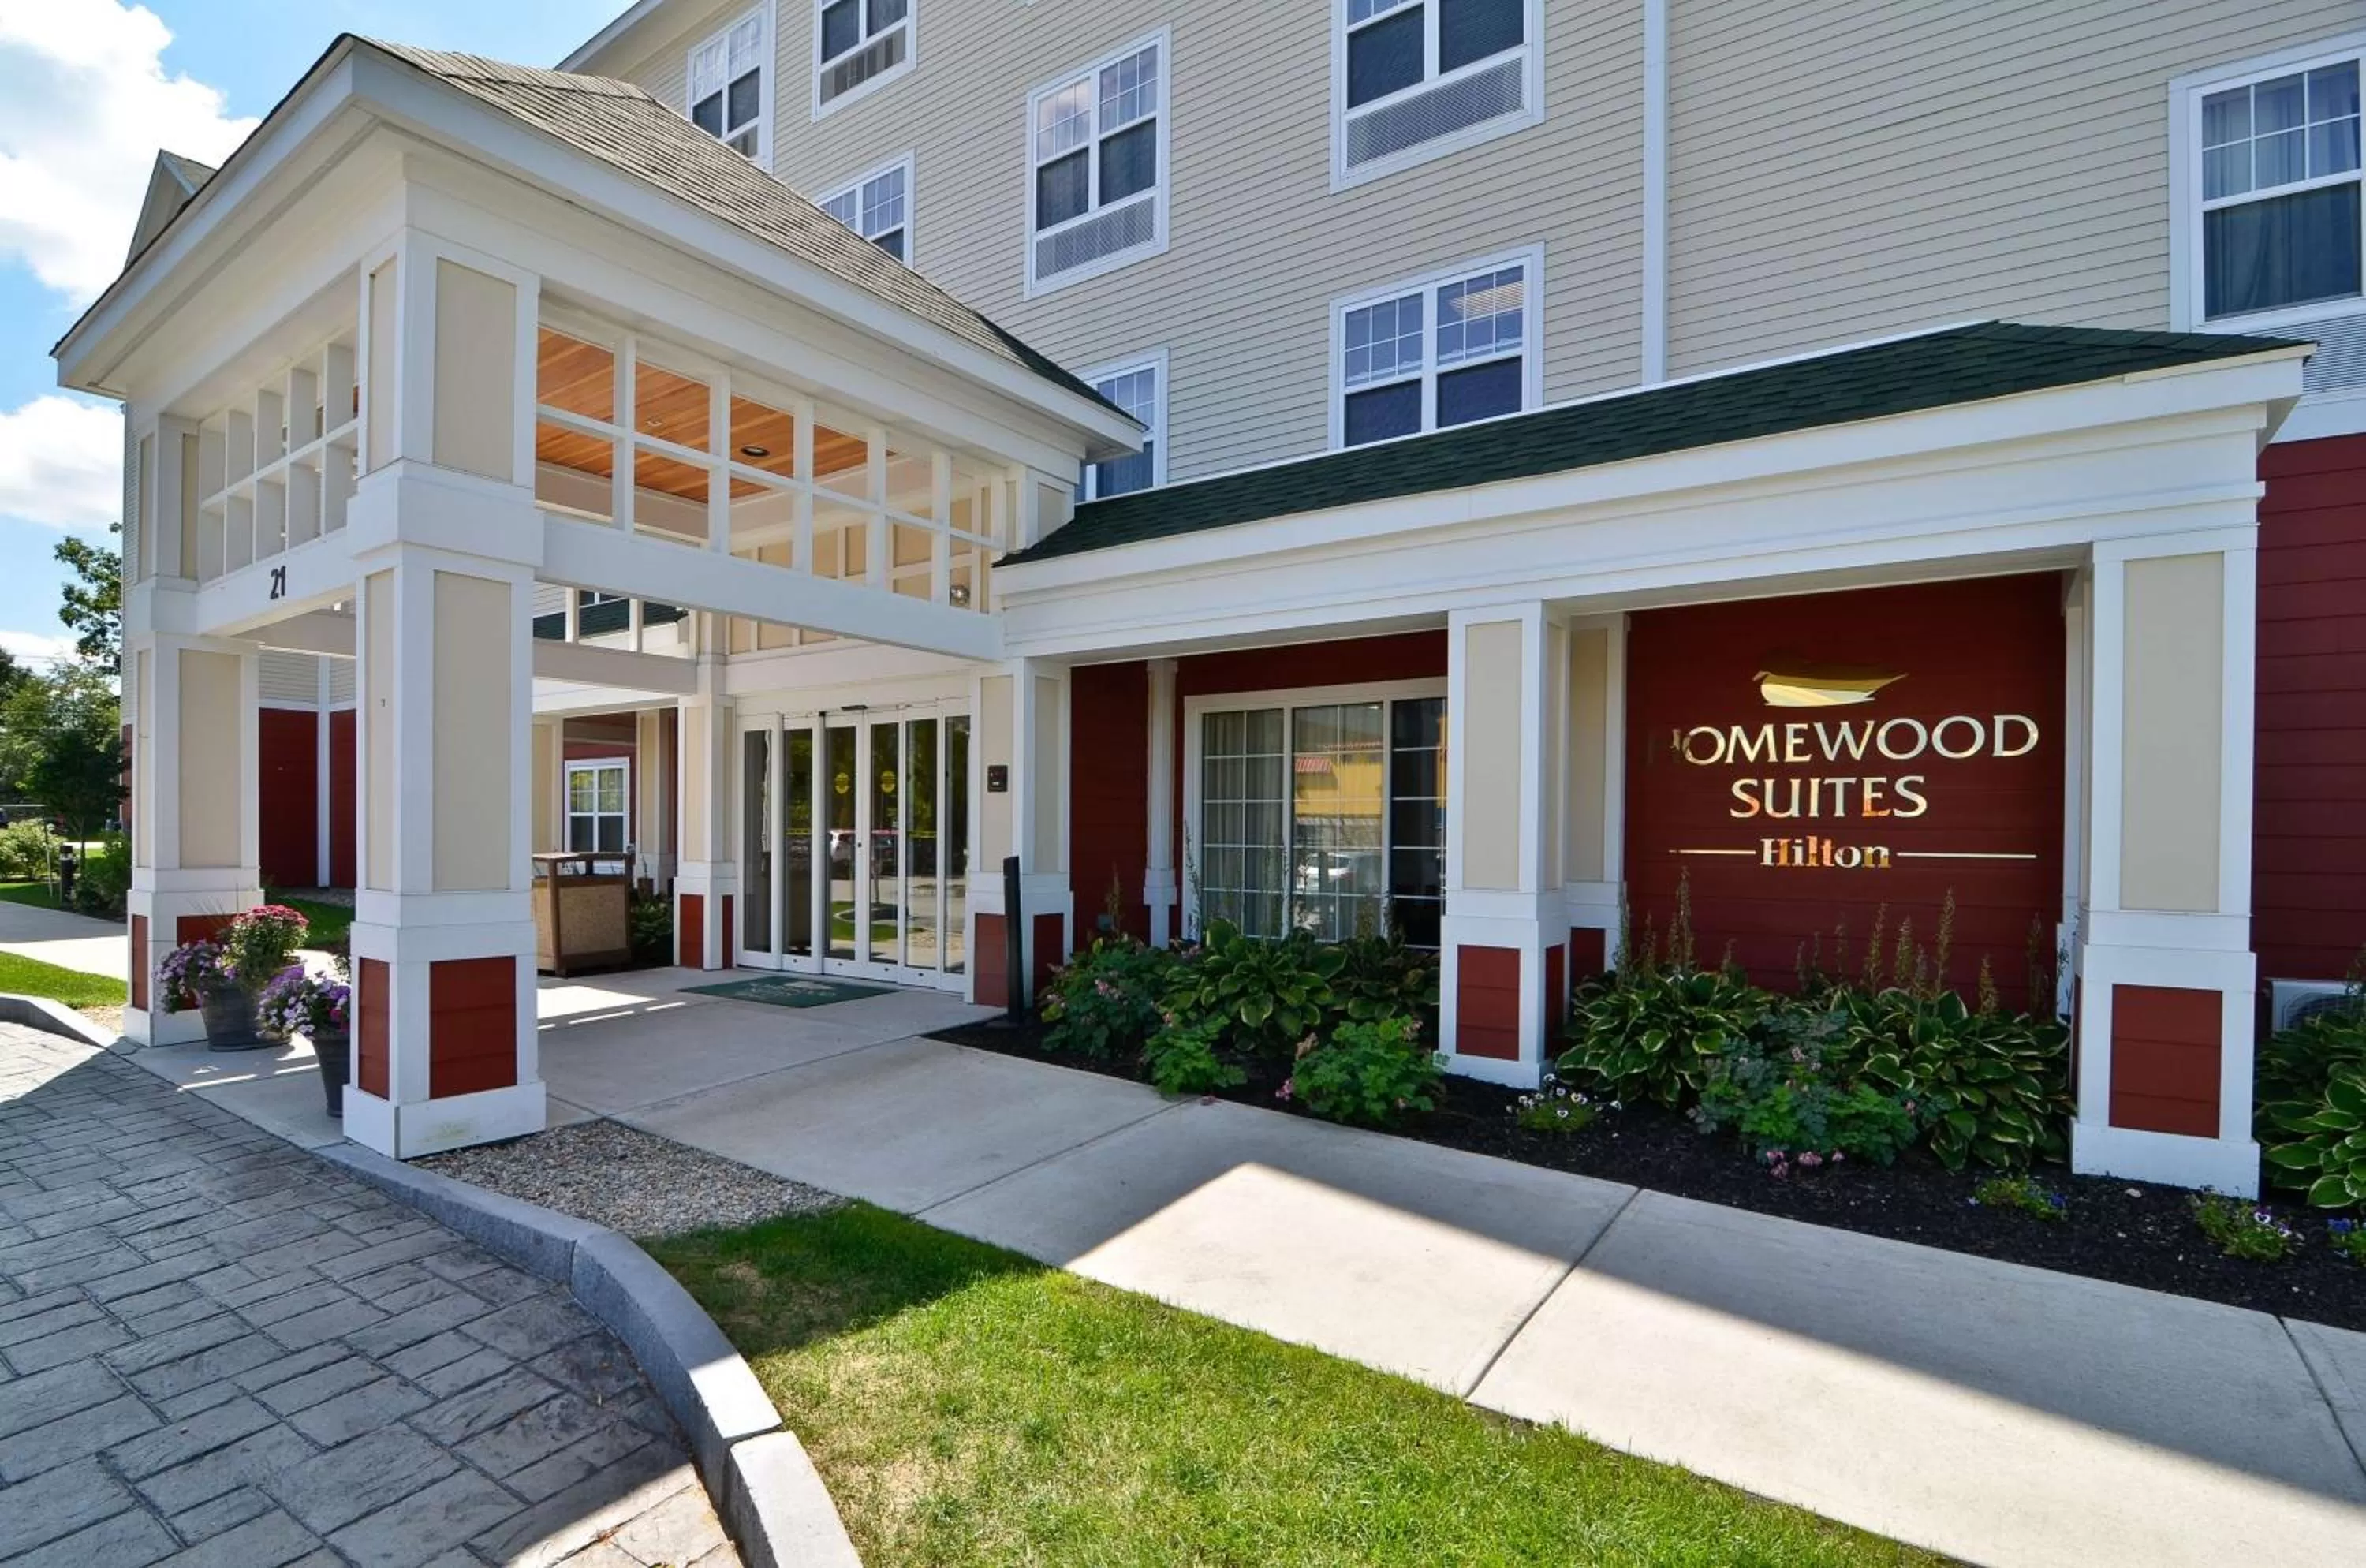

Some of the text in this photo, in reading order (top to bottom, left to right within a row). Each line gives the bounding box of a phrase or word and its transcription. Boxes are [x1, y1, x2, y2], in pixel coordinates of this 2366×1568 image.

[270, 566, 286, 599] 21
[1668, 715, 2039, 765] OMEWOOD
[1730, 775, 1928, 819] SUITES
[1760, 835, 1892, 868] Hilton
